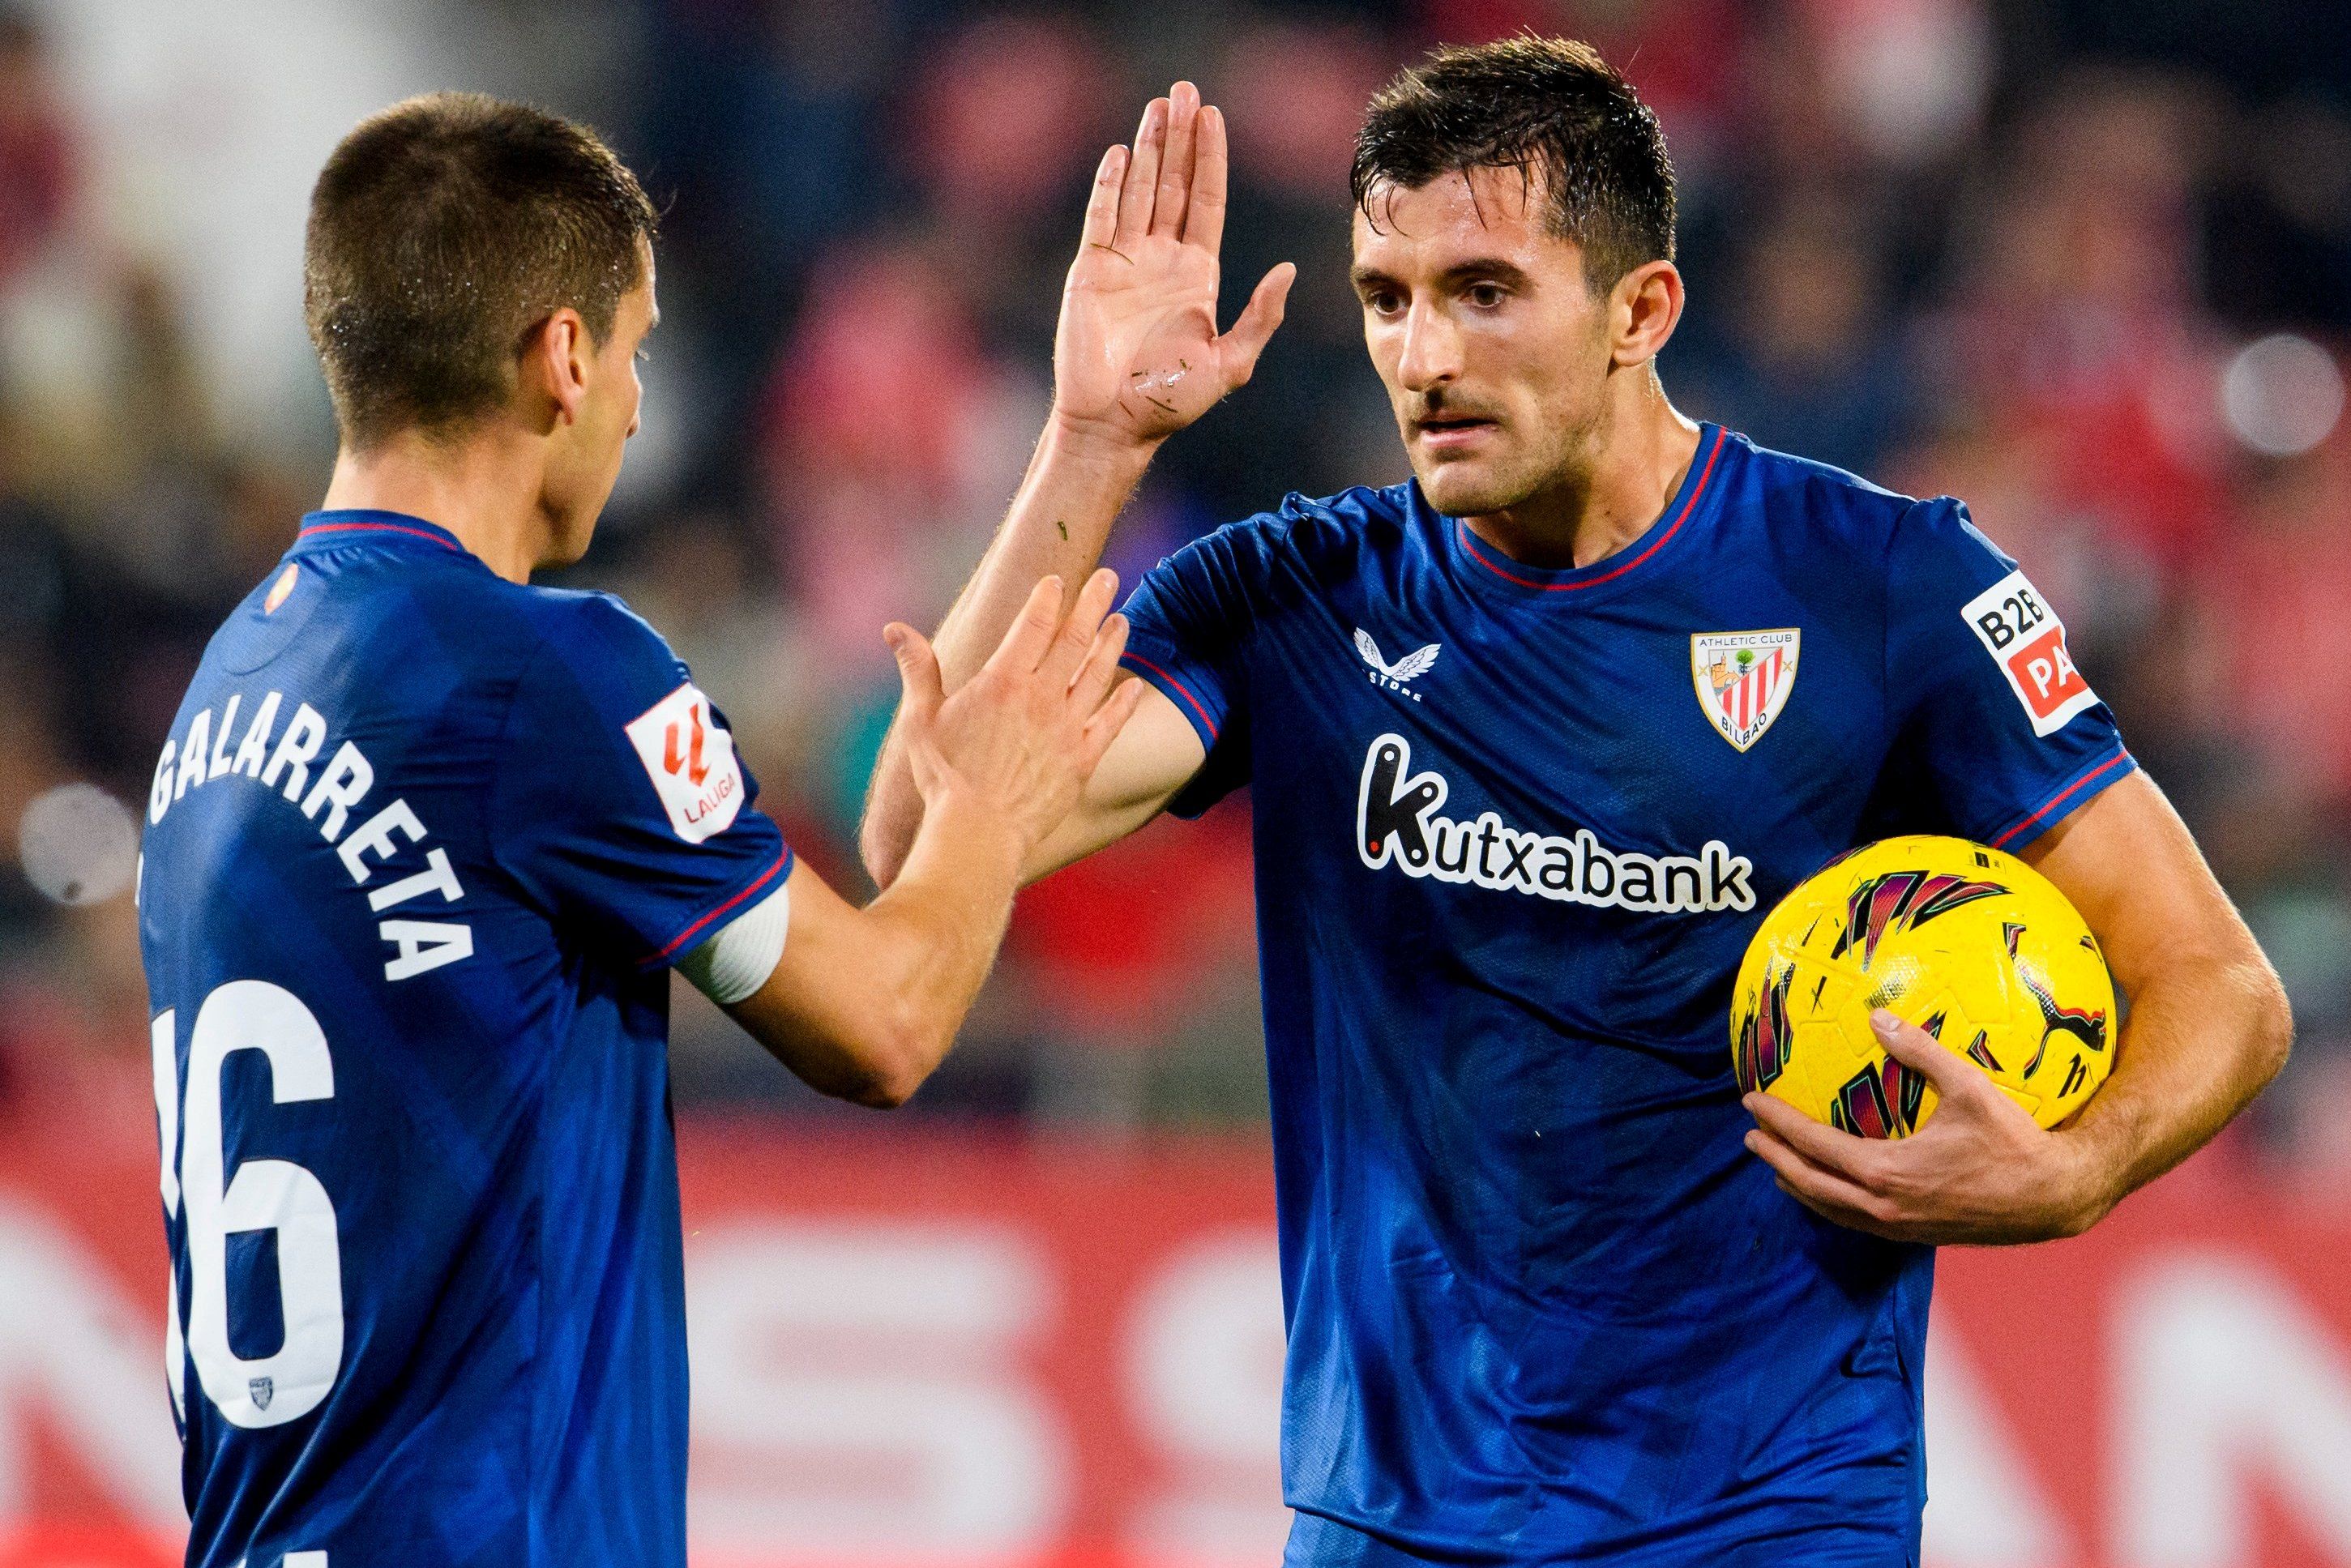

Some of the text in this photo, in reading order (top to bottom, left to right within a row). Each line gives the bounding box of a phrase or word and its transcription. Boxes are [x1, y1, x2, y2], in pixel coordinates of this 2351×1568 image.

[1699, 634, 1793, 647] ATHLETIC CLUB
[1977, 589, 2045, 651] B2B
[1369, 671, 1422, 702] STORE
[1721, 712, 1767, 745] BILBAO
[684, 772, 735, 823] LALIGA
[1364, 741, 1749, 905] Kutxabank
[151, 691, 474, 981] GALARRETA
